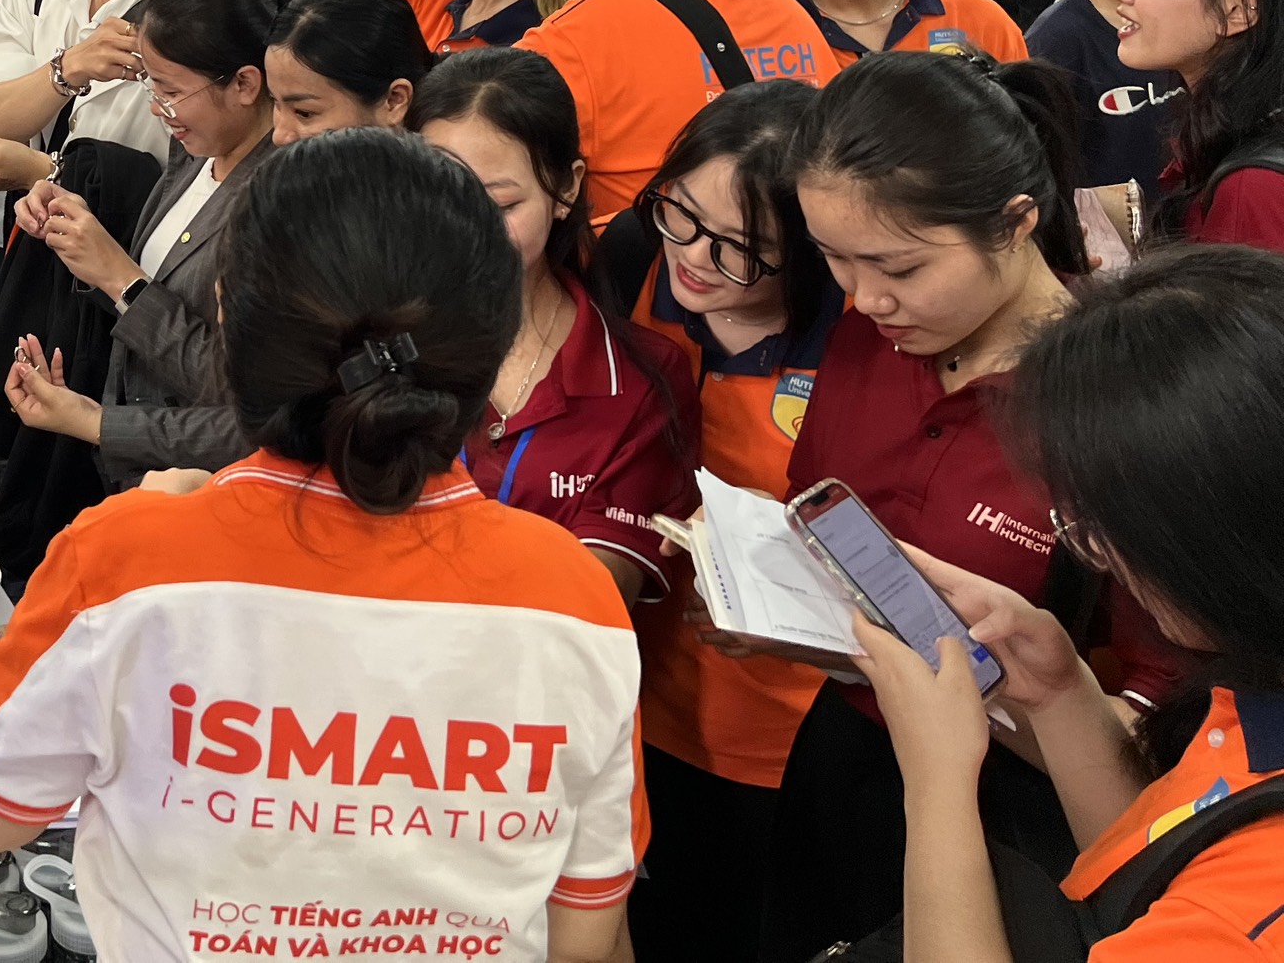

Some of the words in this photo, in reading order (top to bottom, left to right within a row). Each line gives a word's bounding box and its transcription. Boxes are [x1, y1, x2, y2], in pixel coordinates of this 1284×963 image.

[700, 42, 816, 83] HTECH
[999, 527, 1051, 555] HUTECH
[169, 682, 568, 794] iSMART
[162, 776, 559, 841] i-GENERATION
[193, 898, 261, 933] HỌC
[270, 900, 363, 928] TIẾNG
[369, 908, 439, 927] ANH
[446, 911, 510, 934] QUA
[189, 929, 277, 956] TOÁN
[287, 930, 330, 958] VÀ
[338, 934, 427, 956] KHOA
[437, 934, 504, 960] HỌC
